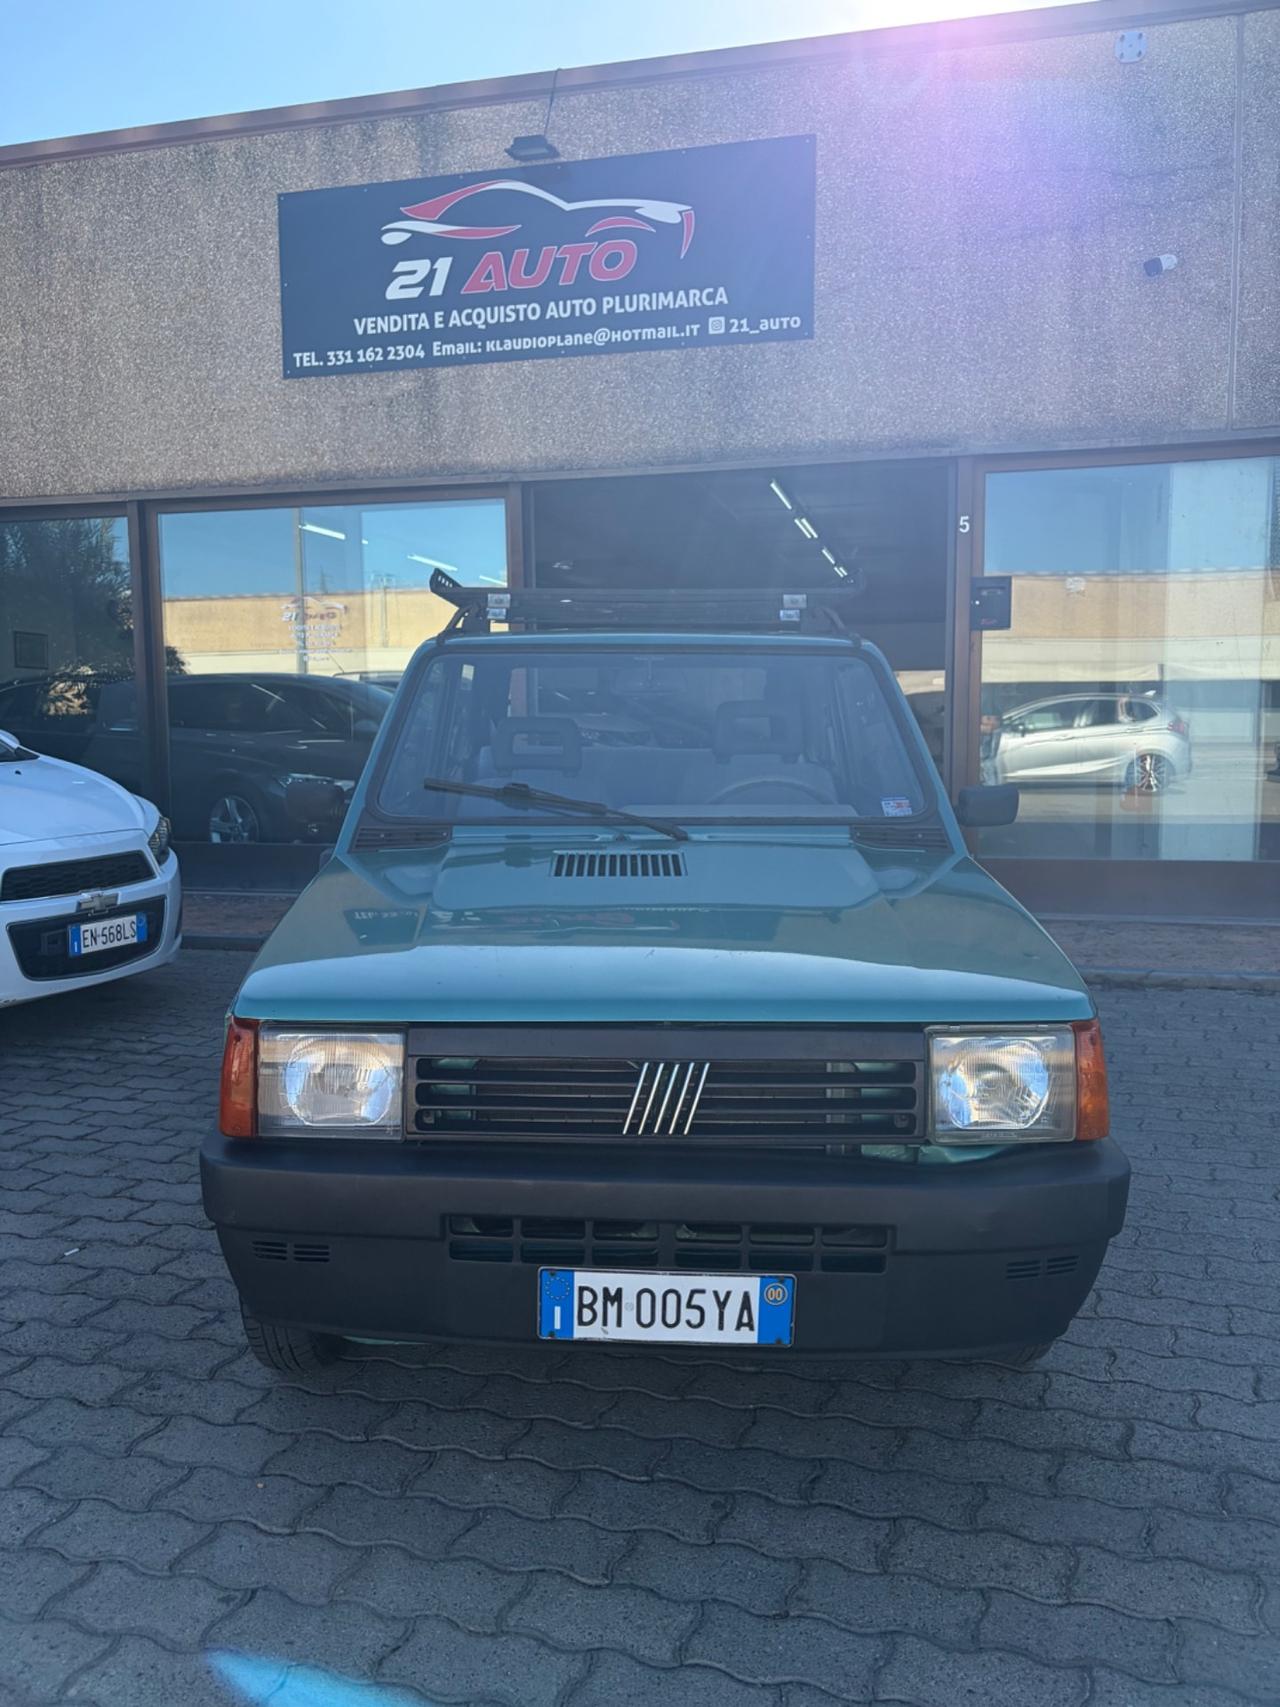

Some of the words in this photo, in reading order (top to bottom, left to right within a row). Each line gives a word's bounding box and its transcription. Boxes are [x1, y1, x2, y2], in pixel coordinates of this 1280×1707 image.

[385, 256, 453, 300] 21
[460, 239, 638, 294] AUTO
[353, 312, 430, 335] VENDITA
[434, 311, 444, 329] E
[449, 302, 541, 329] ACQUISTO
[545, 298, 597, 319] AUTO
[602, 286, 729, 315] PLURIMARCA
[293, 352, 324, 368] TEL.
[327, 350, 354, 366] 331
[357, 347, 384, 363] 162
[387, 344, 425, 361] 2304
[959, 515, 970, 533] 5
